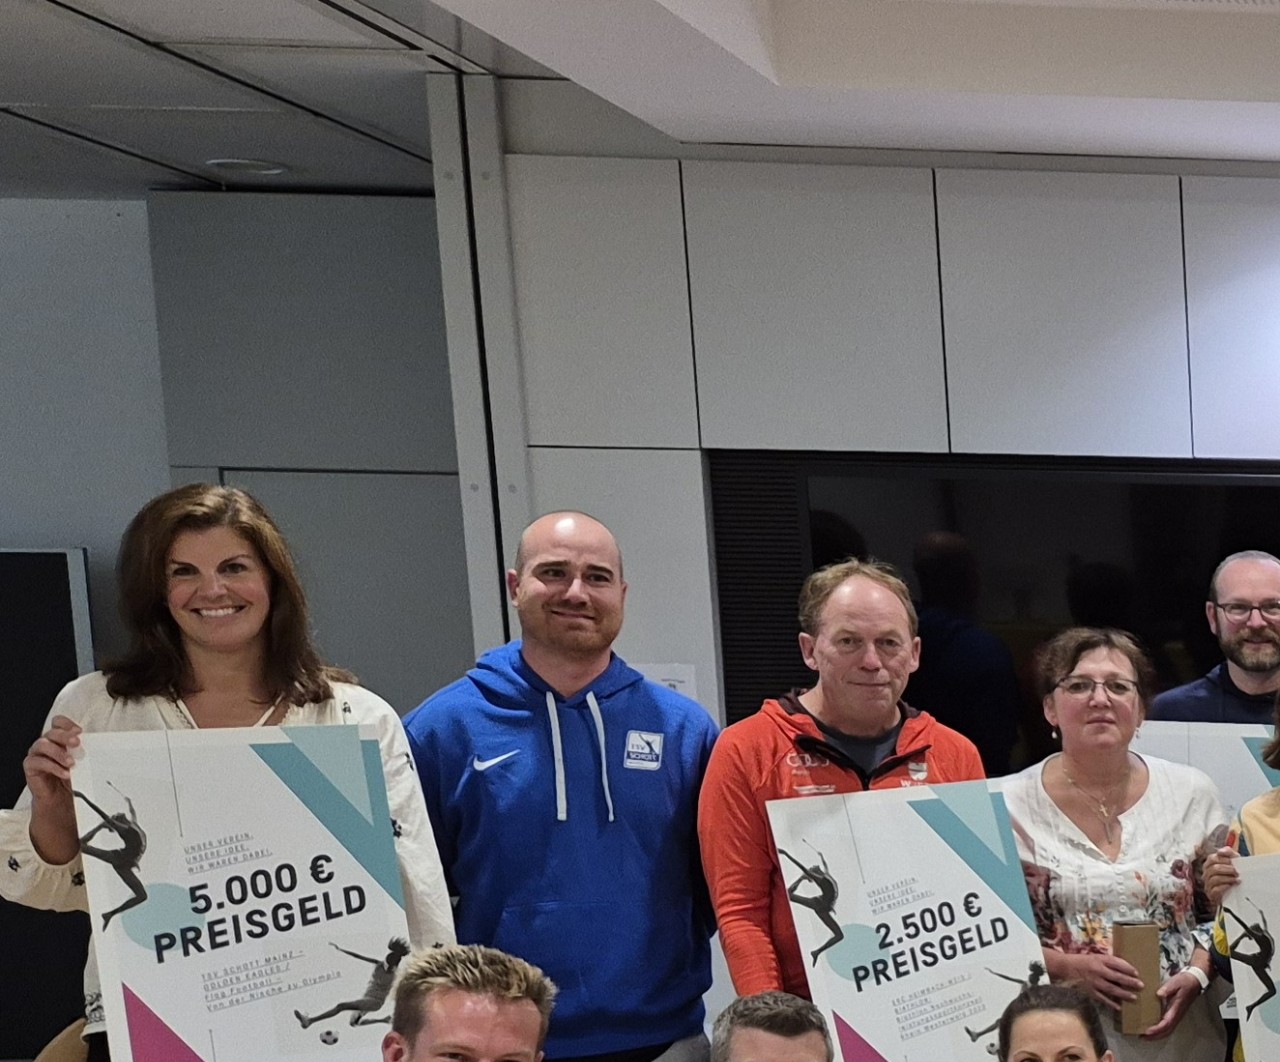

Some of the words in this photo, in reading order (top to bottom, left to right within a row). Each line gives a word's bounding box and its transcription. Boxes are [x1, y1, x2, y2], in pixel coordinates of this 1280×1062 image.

[188, 863, 298, 915] 5.000
[309, 854, 335, 884] €
[153, 885, 366, 964] PREISGELD
[852, 917, 1009, 993] PREISGELD
[875, 901, 955, 950] 2.500
[963, 892, 982, 918] €
